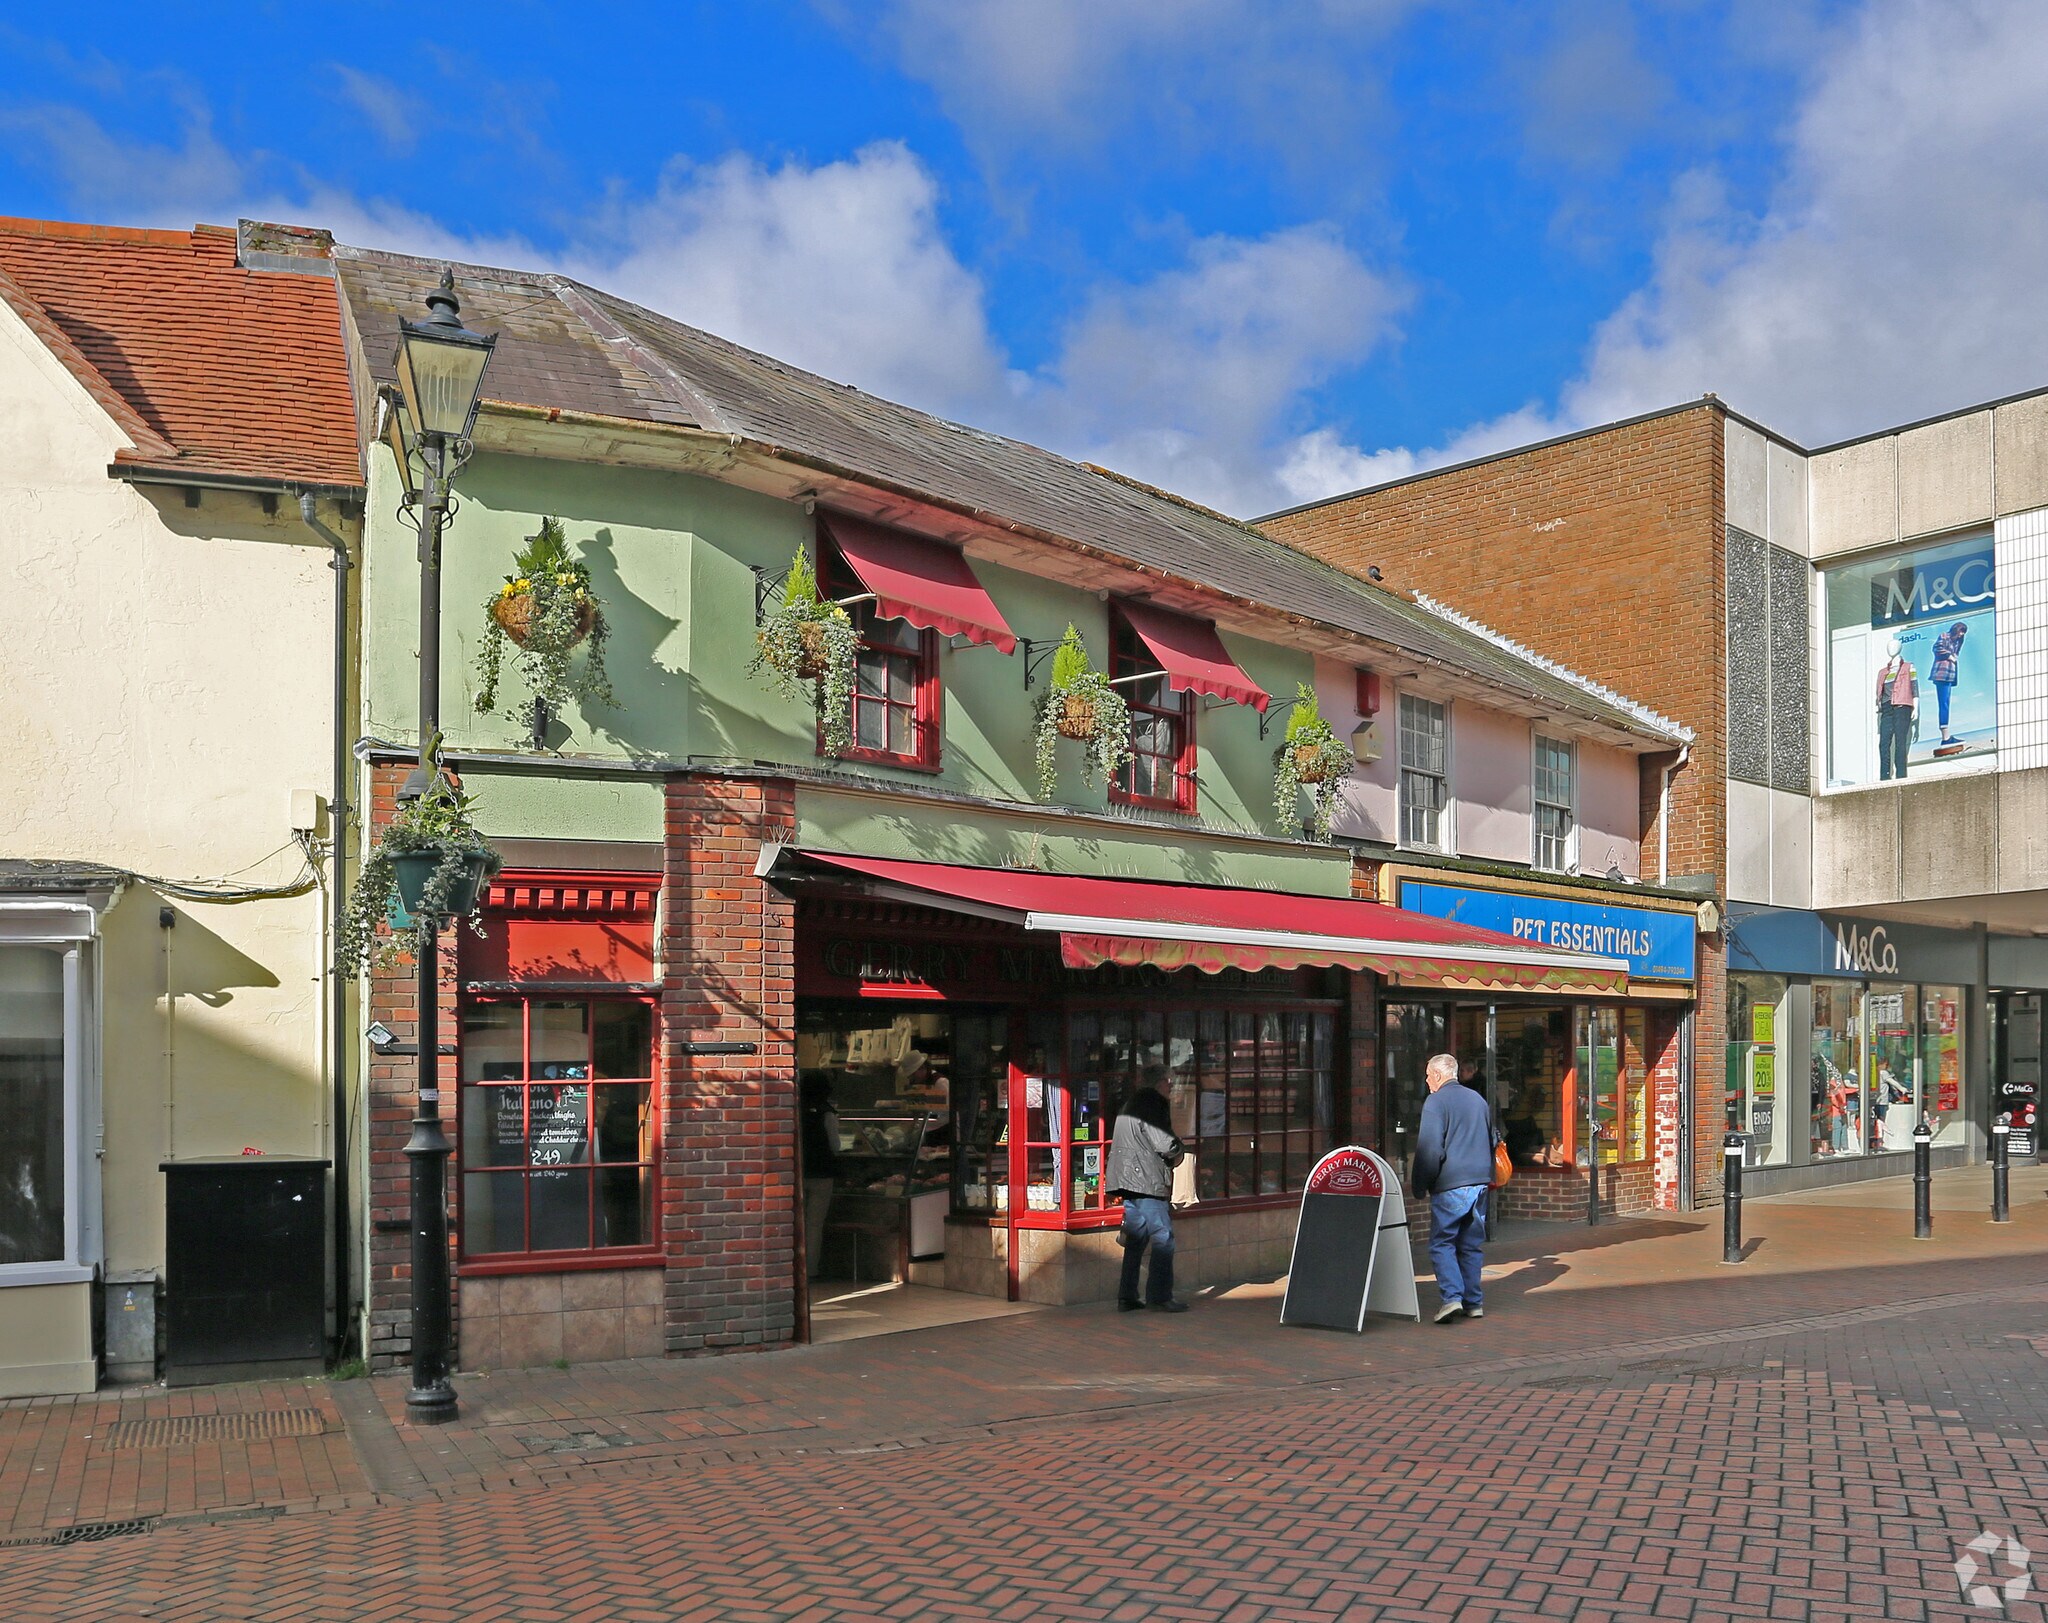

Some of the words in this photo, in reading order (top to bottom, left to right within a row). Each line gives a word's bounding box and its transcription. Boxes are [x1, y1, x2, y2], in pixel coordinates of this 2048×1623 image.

[1551, 921, 1649, 956] ESSENTIALS
[1835, 922, 1899, 975] M&Co.
[825, 936, 981, 982] GERRY
[1755, 1021, 1772, 1036] DEAL
[499, 1093, 553, 1110] Italano
[1753, 1111, 1771, 1125] ENDS
[1311, 1159, 1341, 1188] GERRY
[1343, 1158, 1380, 1189] MARTINS
